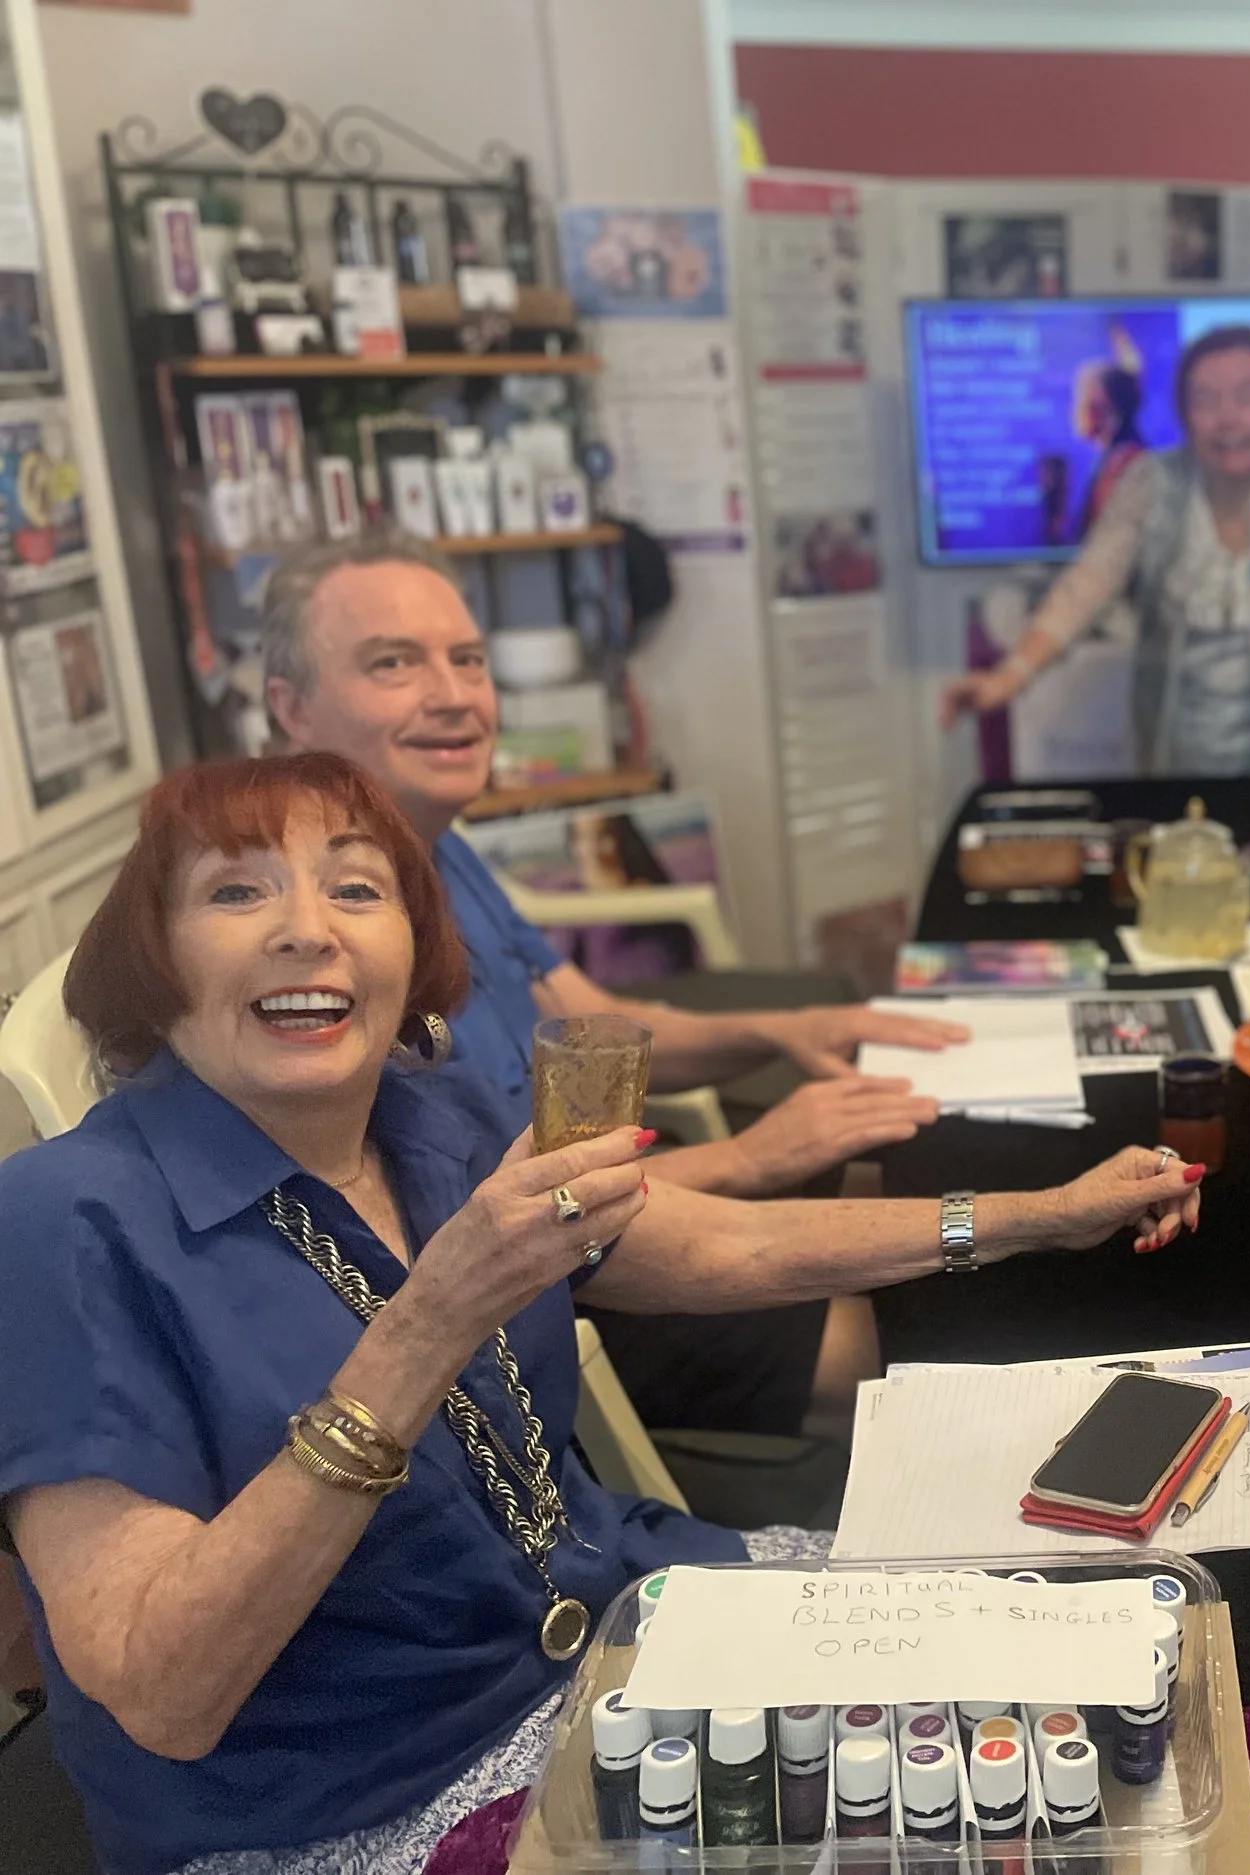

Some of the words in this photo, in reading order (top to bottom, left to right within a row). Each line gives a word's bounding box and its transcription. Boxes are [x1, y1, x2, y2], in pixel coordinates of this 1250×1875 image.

[801, 1579, 974, 1600] SPIRITUAL
[792, 1601, 956, 1626] BLENDS
[969, 1603, 992, 1617] +
[1007, 1606, 1134, 1625] SINGLES
[814, 1636, 922, 1657] OPEN
